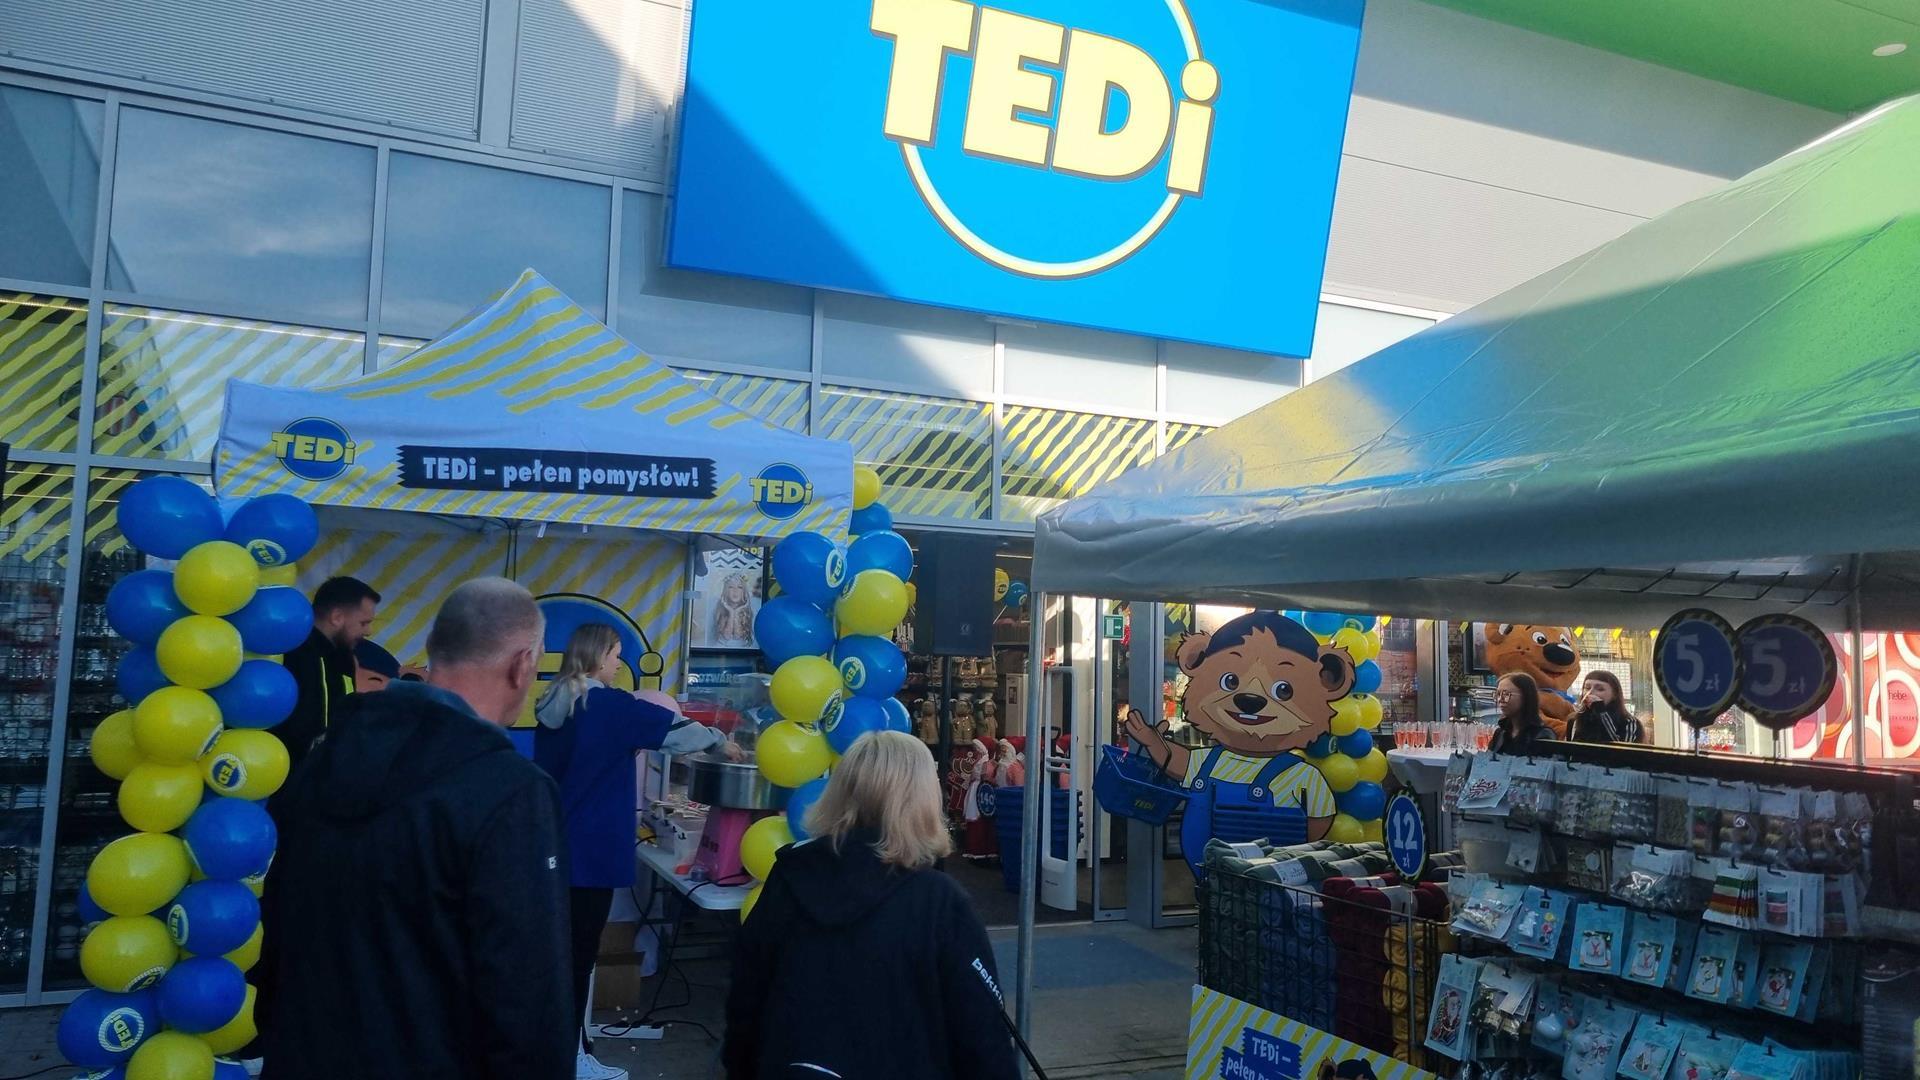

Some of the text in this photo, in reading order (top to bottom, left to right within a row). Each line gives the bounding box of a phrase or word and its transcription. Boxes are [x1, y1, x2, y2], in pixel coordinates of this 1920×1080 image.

[870, 0, 1217, 197] TEDi
[272, 432, 356, 465] TEDi
[423, 457, 476, 480] TEDi
[503, 459, 571, 488] pełen
[578, 463, 699, 492] pomysłów!
[751, 477, 813, 505] TEDi
[1676, 633, 1720, 693] 5 zł
[1749, 638, 1806, 697] 5 zł
[1393, 810, 1418, 850] 12
[110, 1014, 134, 1048] TEDi
[1252, 1036, 1279, 1065] TEDi
